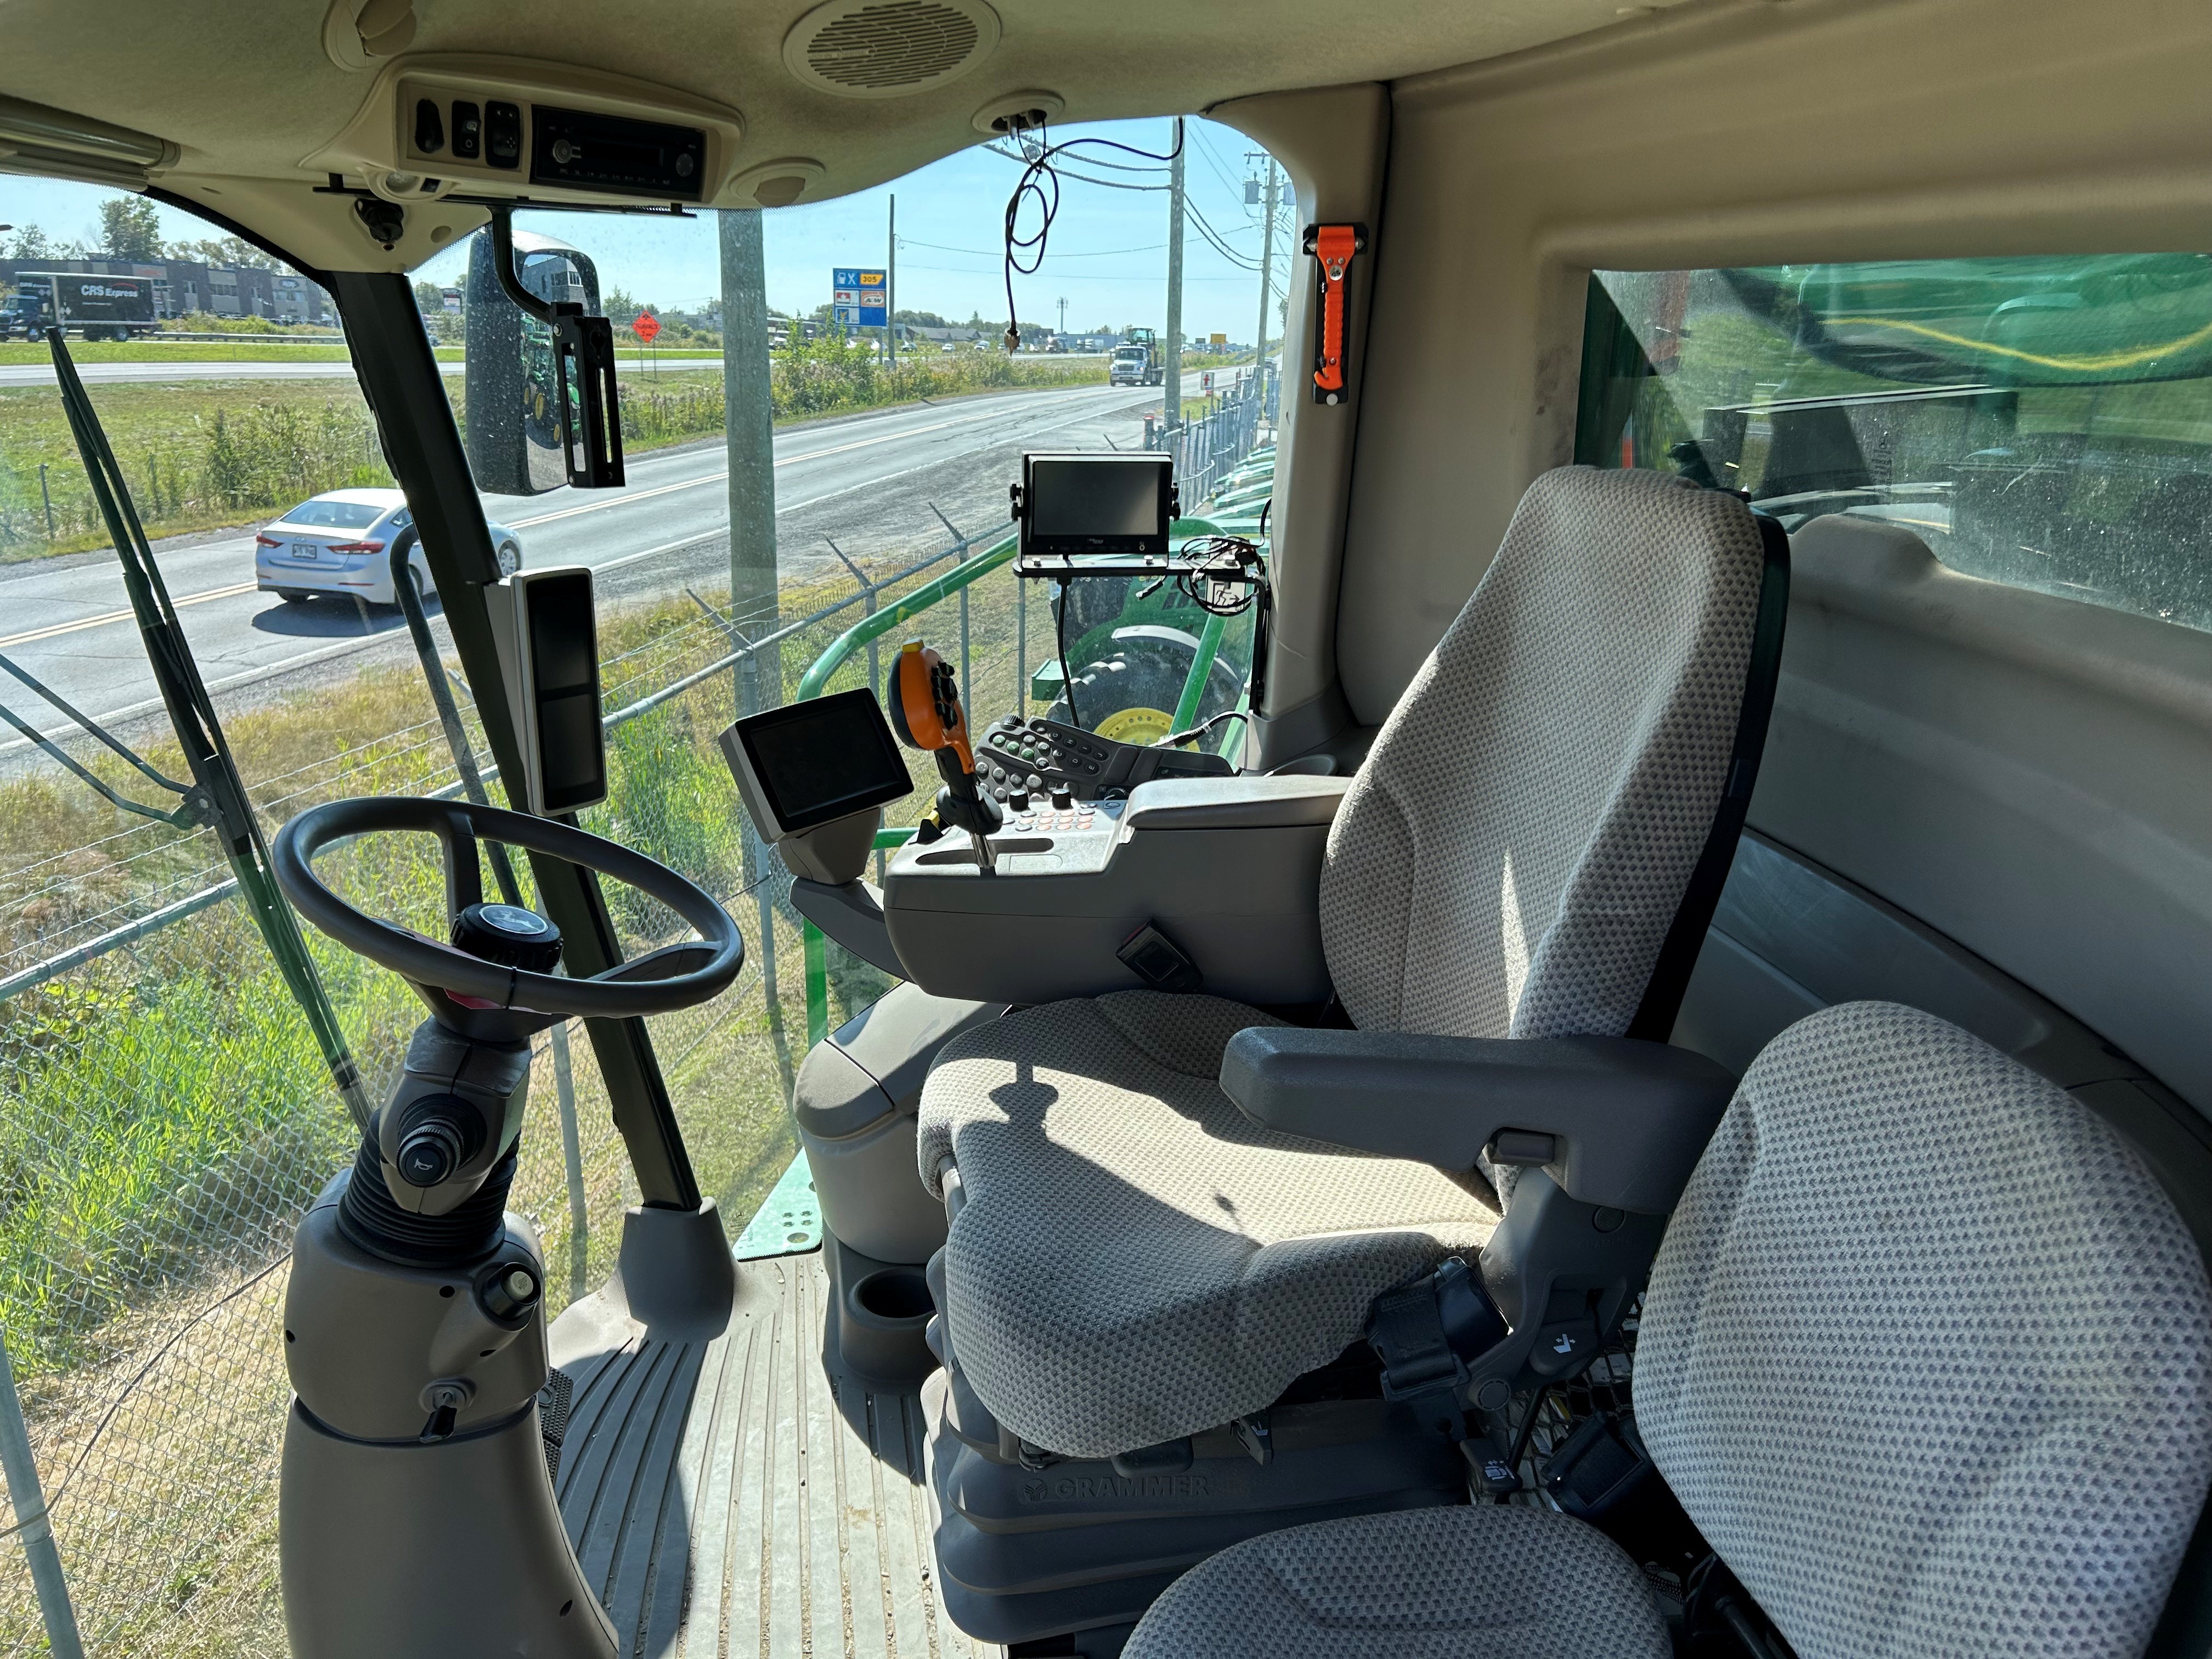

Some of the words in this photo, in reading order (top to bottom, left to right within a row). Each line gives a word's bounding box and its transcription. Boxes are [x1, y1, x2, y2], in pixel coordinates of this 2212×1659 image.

[81, 285, 105, 296] CRS
[105, 288, 138, 298] Express
[1055, 1476, 1209, 1498] GRAMMER
